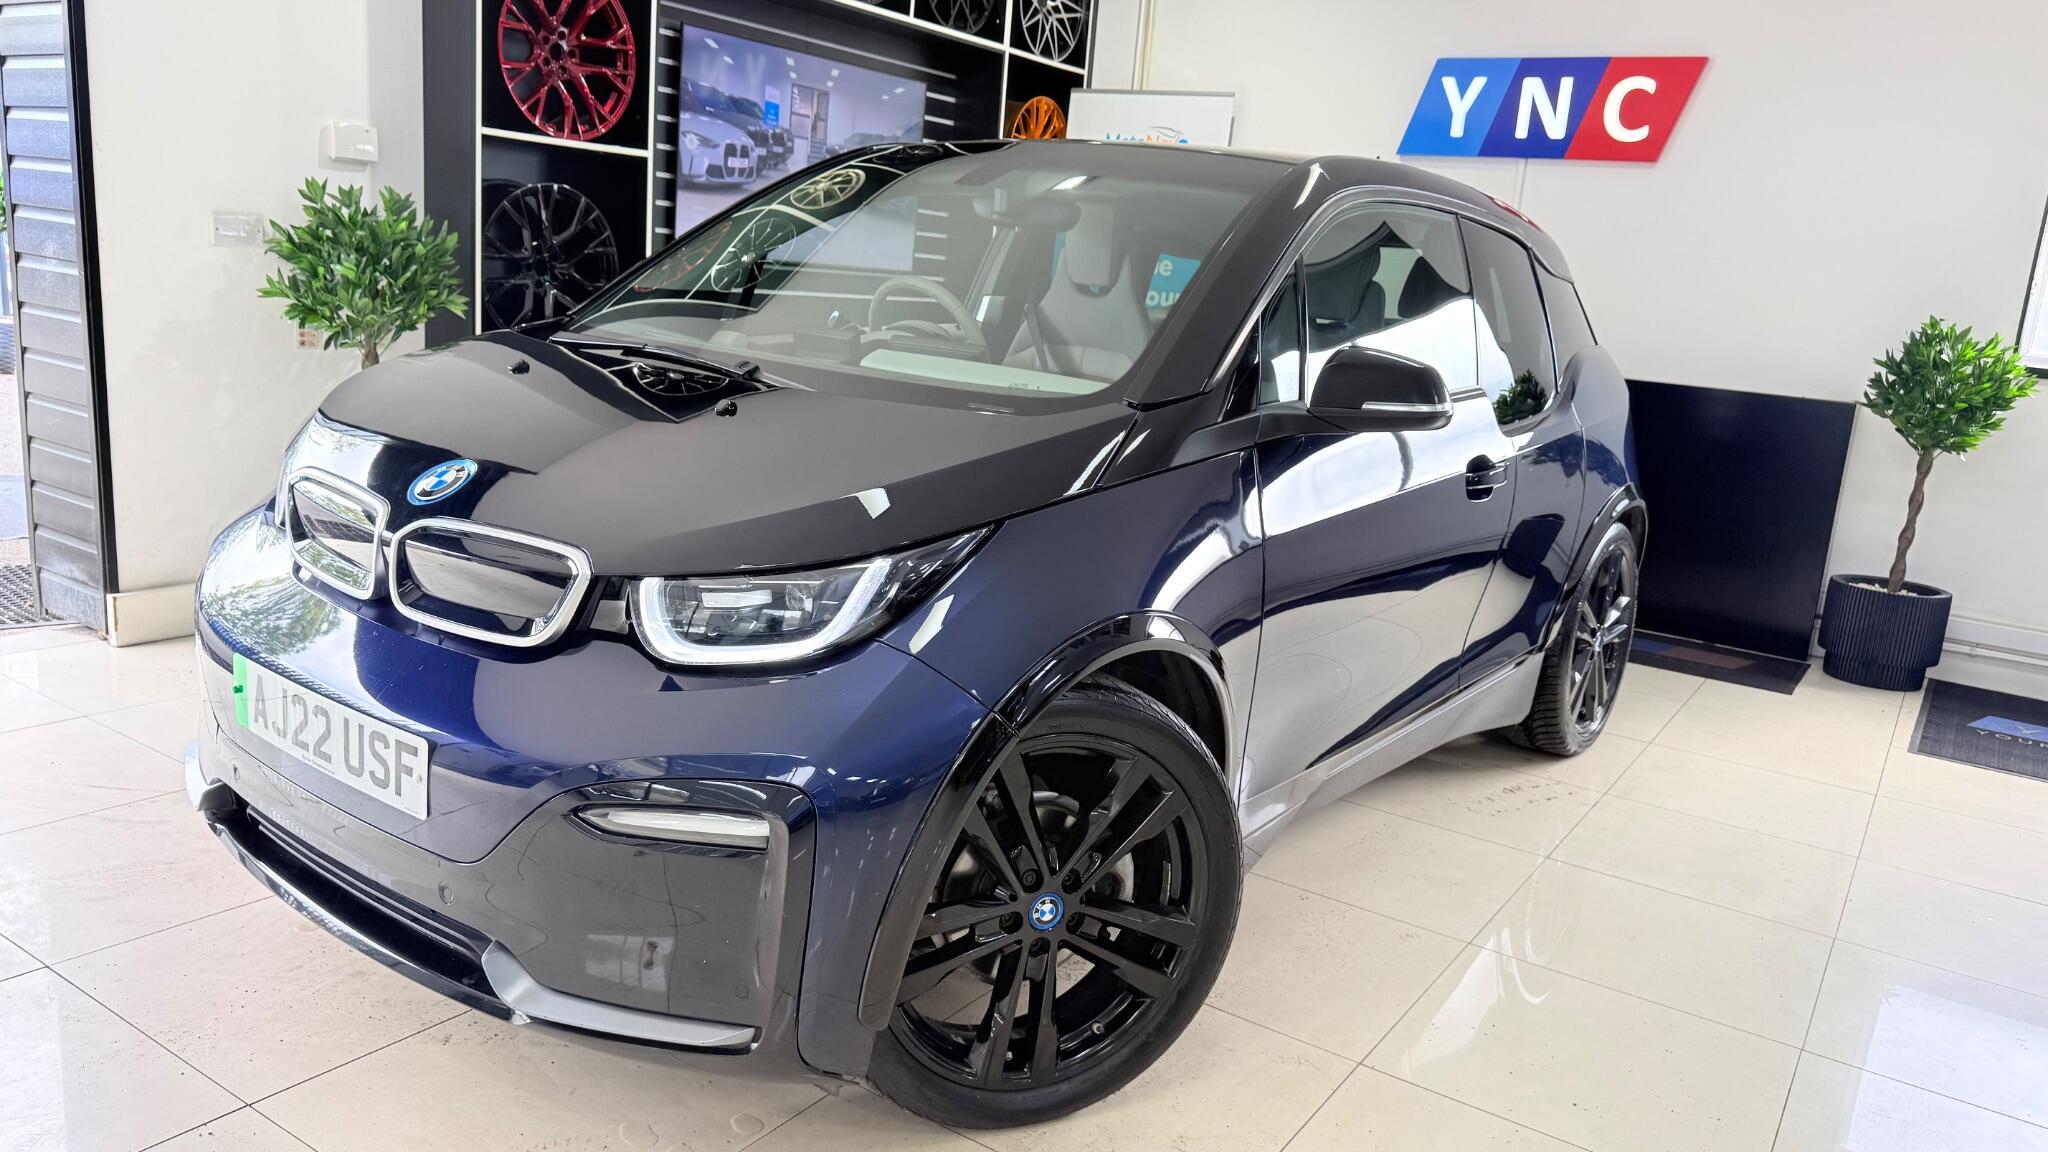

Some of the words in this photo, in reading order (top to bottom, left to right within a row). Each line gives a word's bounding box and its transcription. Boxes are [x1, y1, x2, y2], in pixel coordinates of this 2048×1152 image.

[1441, 75, 1657, 143] YNC
[253, 673, 333, 765] AJ22
[343, 716, 419, 798] USF
